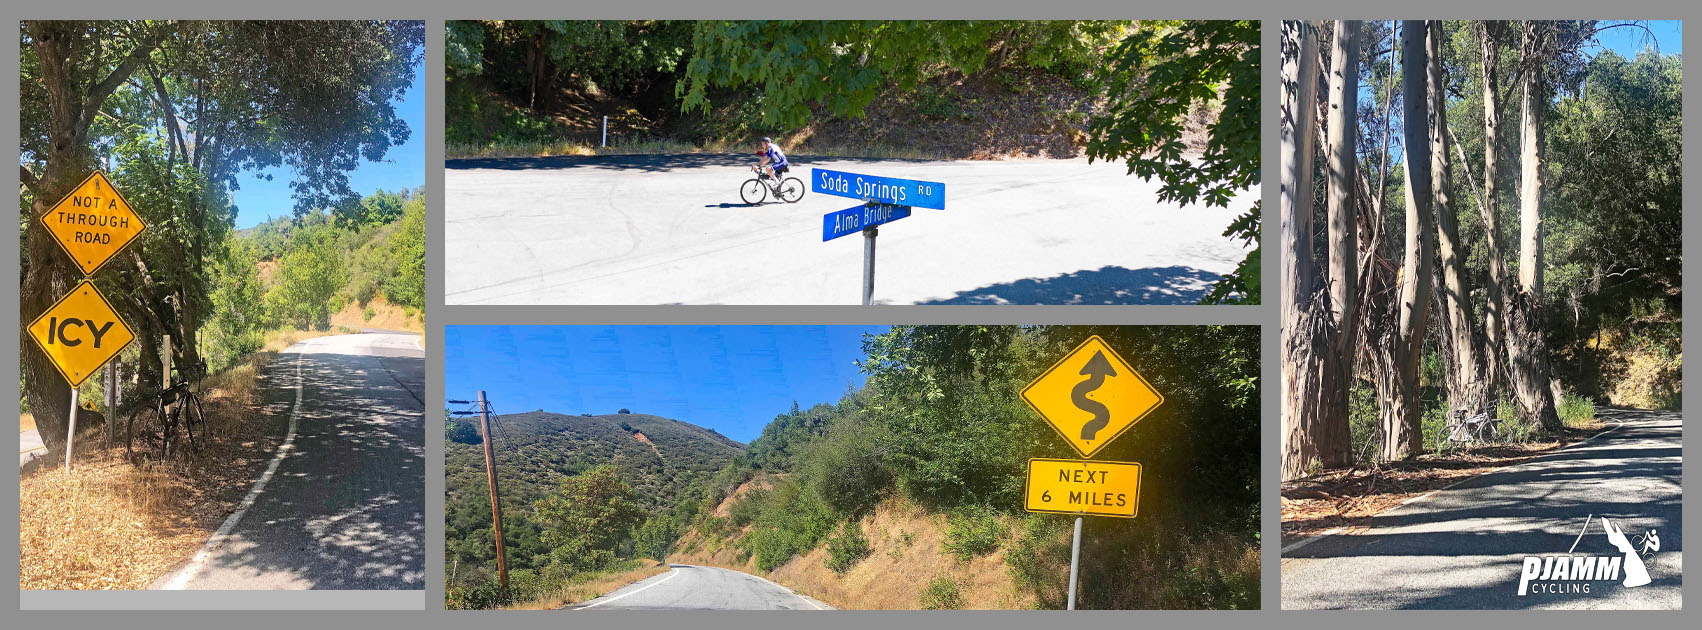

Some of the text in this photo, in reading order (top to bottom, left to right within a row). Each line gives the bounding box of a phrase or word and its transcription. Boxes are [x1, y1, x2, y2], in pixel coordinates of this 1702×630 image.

[821, 171, 932, 204] Soda Springs RD
[73, 196, 118, 210] NOT A
[58, 212, 129, 229] THROUGH
[834, 203, 892, 234] Alma Bridge
[75, 232, 111, 245] ROAD
[47, 316, 115, 349] ICY
[1059, 469, 1108, 484] NEXT
[1041, 489, 1126, 507] 6 MILES
